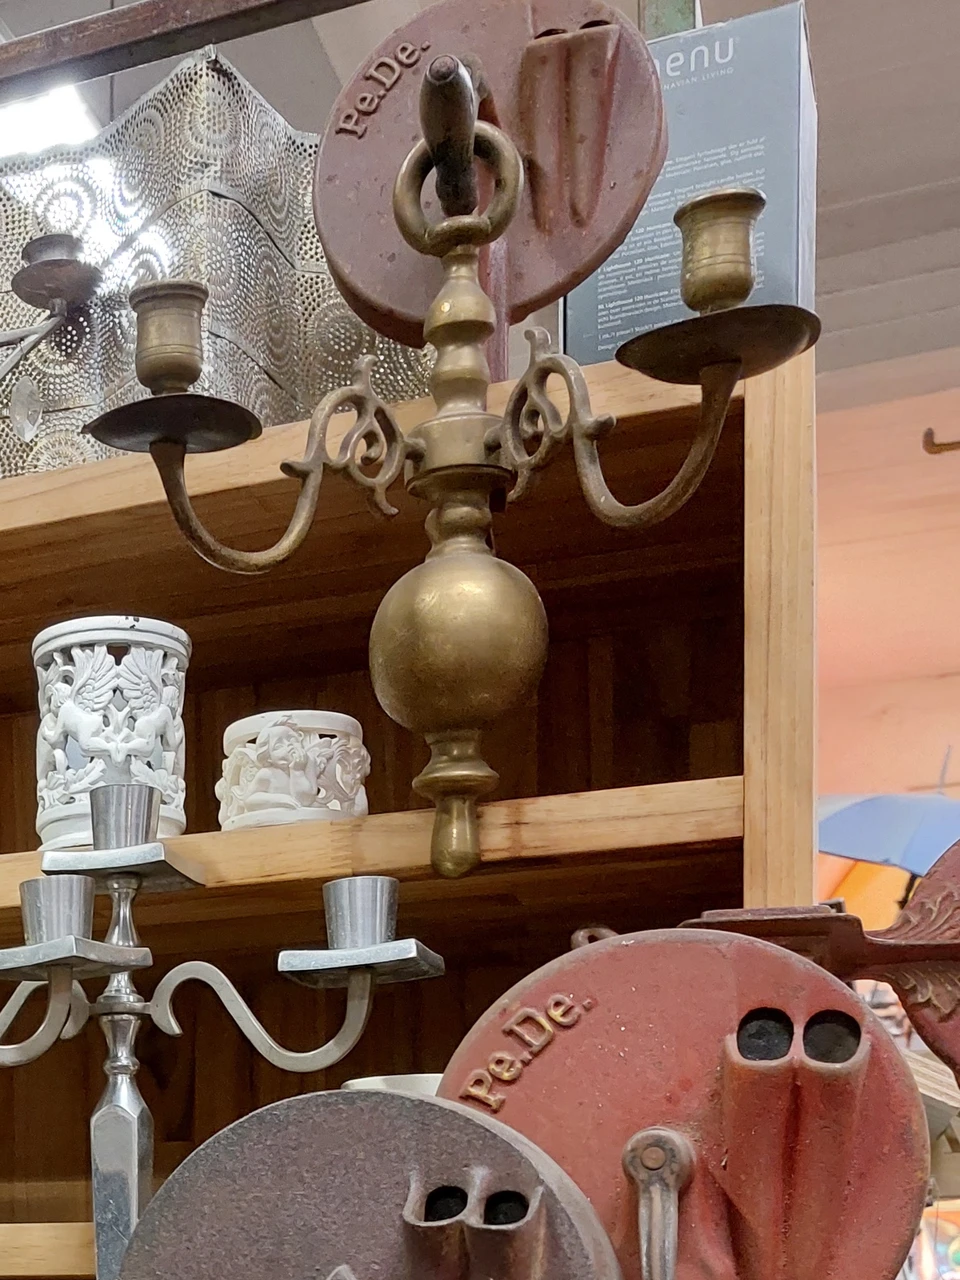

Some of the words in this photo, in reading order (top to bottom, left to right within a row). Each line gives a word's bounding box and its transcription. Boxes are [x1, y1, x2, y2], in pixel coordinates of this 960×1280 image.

[335, 41, 431, 139] Pe.De.
[661, 76, 698, 91] NAVIAN
[702, 67, 734, 81] LIVING
[459, 994, 592, 1113] Pe.De.
